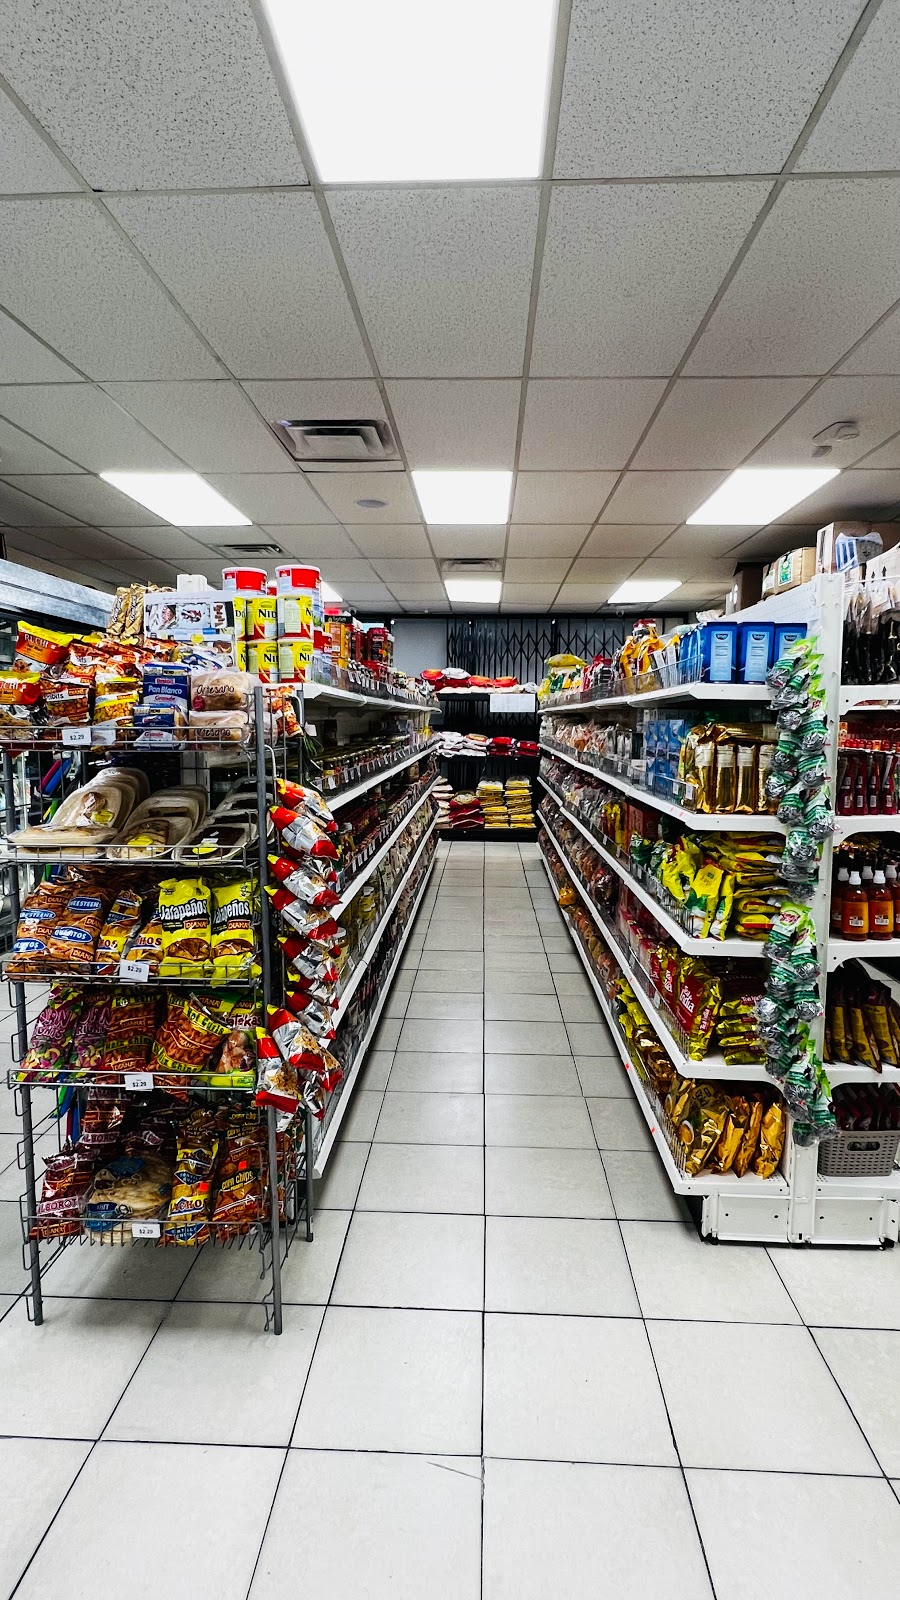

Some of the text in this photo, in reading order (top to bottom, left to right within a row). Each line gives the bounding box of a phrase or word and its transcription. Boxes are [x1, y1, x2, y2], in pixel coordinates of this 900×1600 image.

[24, 633, 49, 648] RUCHI
[148, 685, 182, 695] Pan Blanco
[196, 684, 235, 695] Artesano
[160, 899, 208, 920] Jalapeños
[185, 920, 208, 928] DIANA
[228, 921, 249, 929] DIANA
